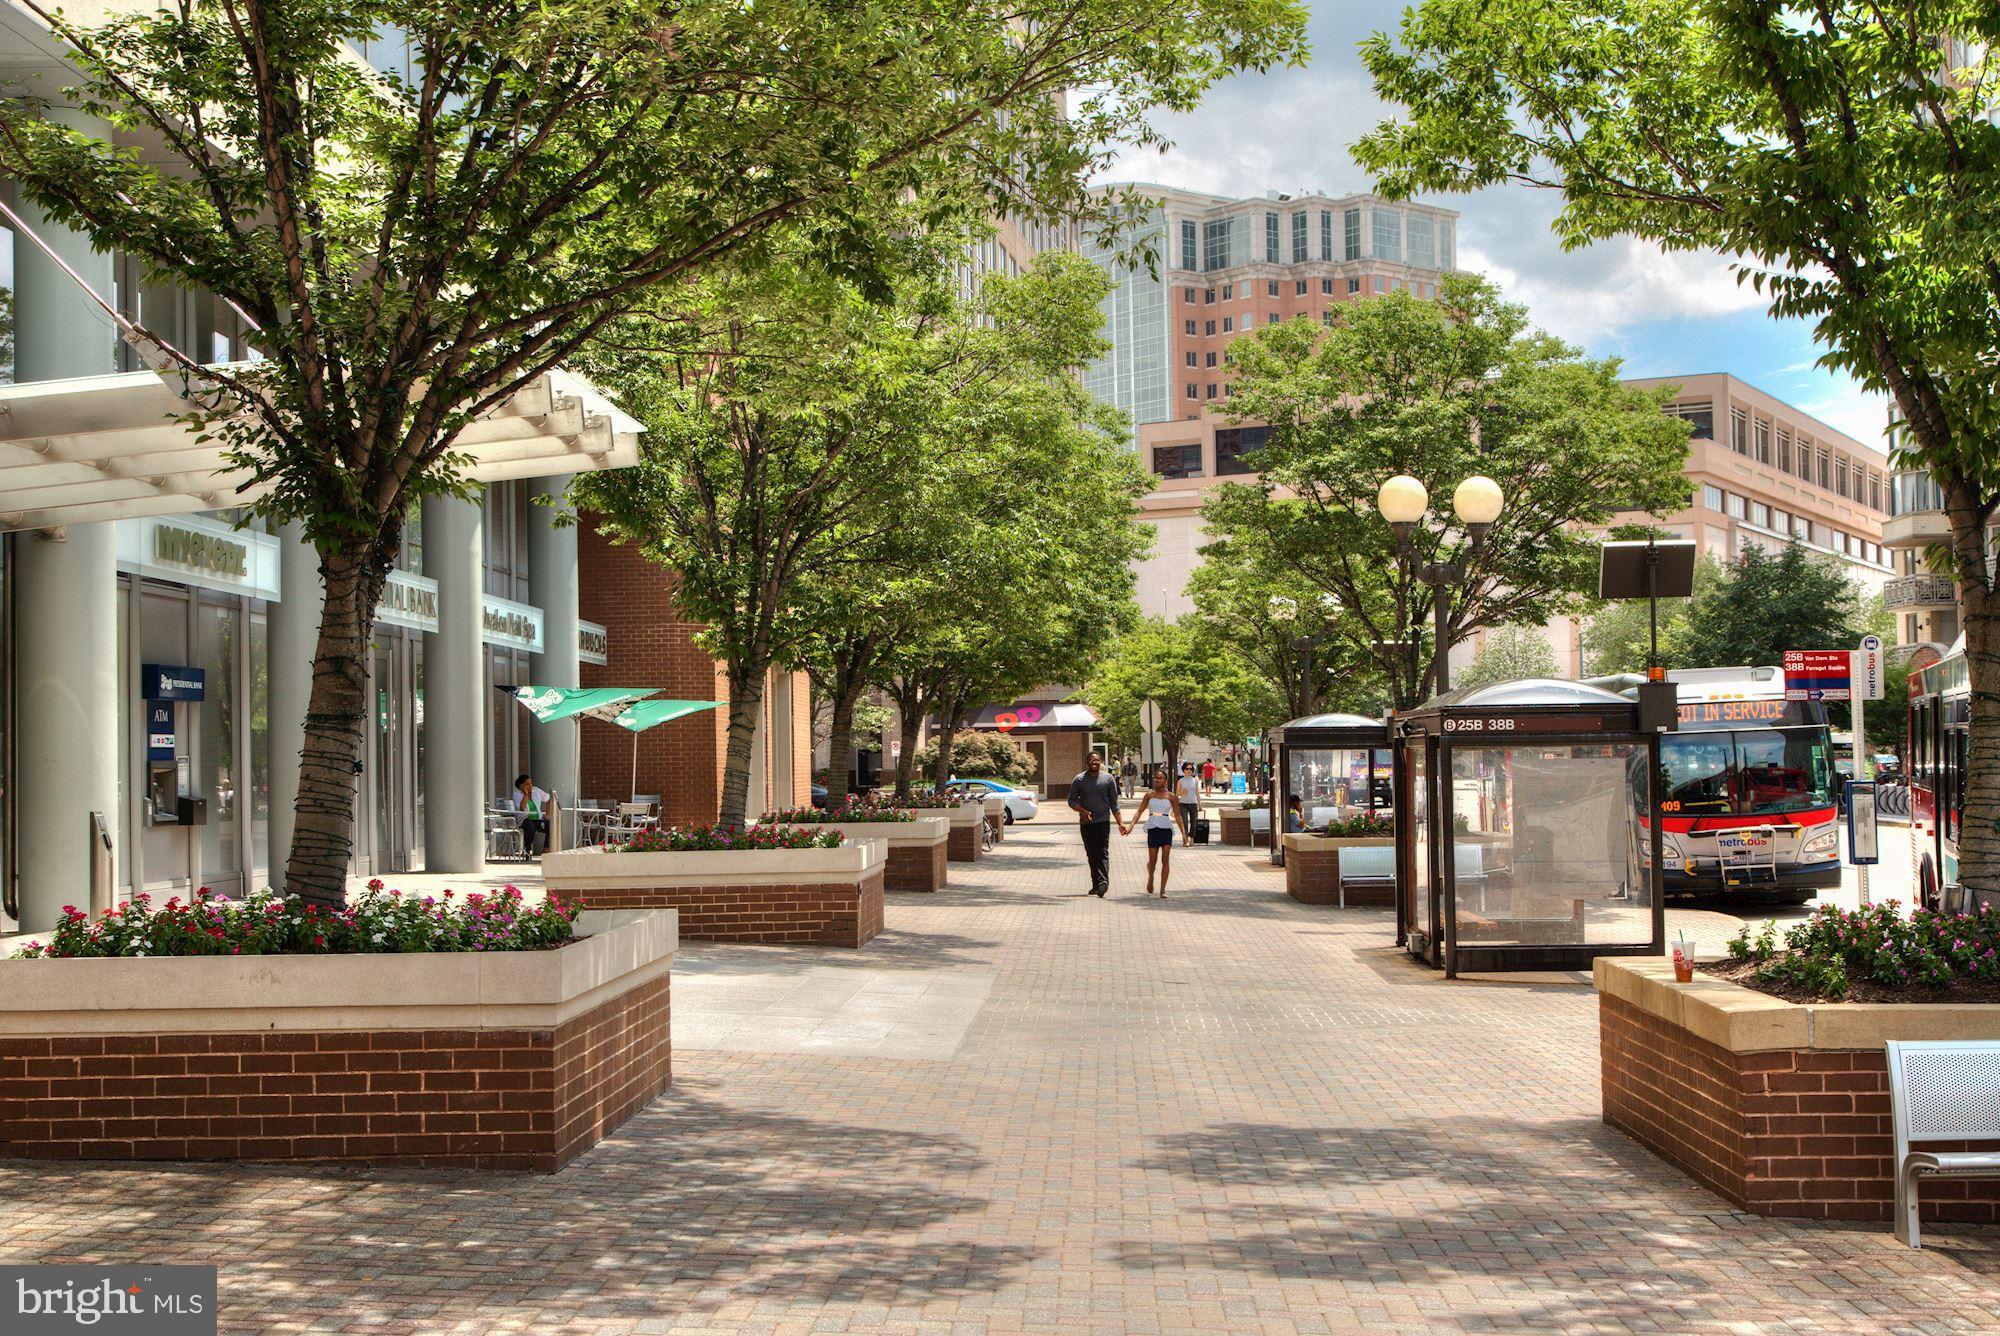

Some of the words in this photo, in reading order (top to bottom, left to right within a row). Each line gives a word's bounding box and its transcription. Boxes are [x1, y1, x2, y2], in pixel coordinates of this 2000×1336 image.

[408, 586, 437, 618] BANK
[579, 630, 607, 655] RBUCKS
[1785, 653, 1803, 662] 25B
[1785, 663, 1804, 671] 38B
[1867, 652, 1876, 698] metrobus
[154, 709, 169, 722] ATM
[1704, 703, 1719, 721] IN
[1723, 700, 1784, 720] SERVICE
[1458, 719, 1483, 731] 25B
[1488, 719, 1515, 731] 38B
